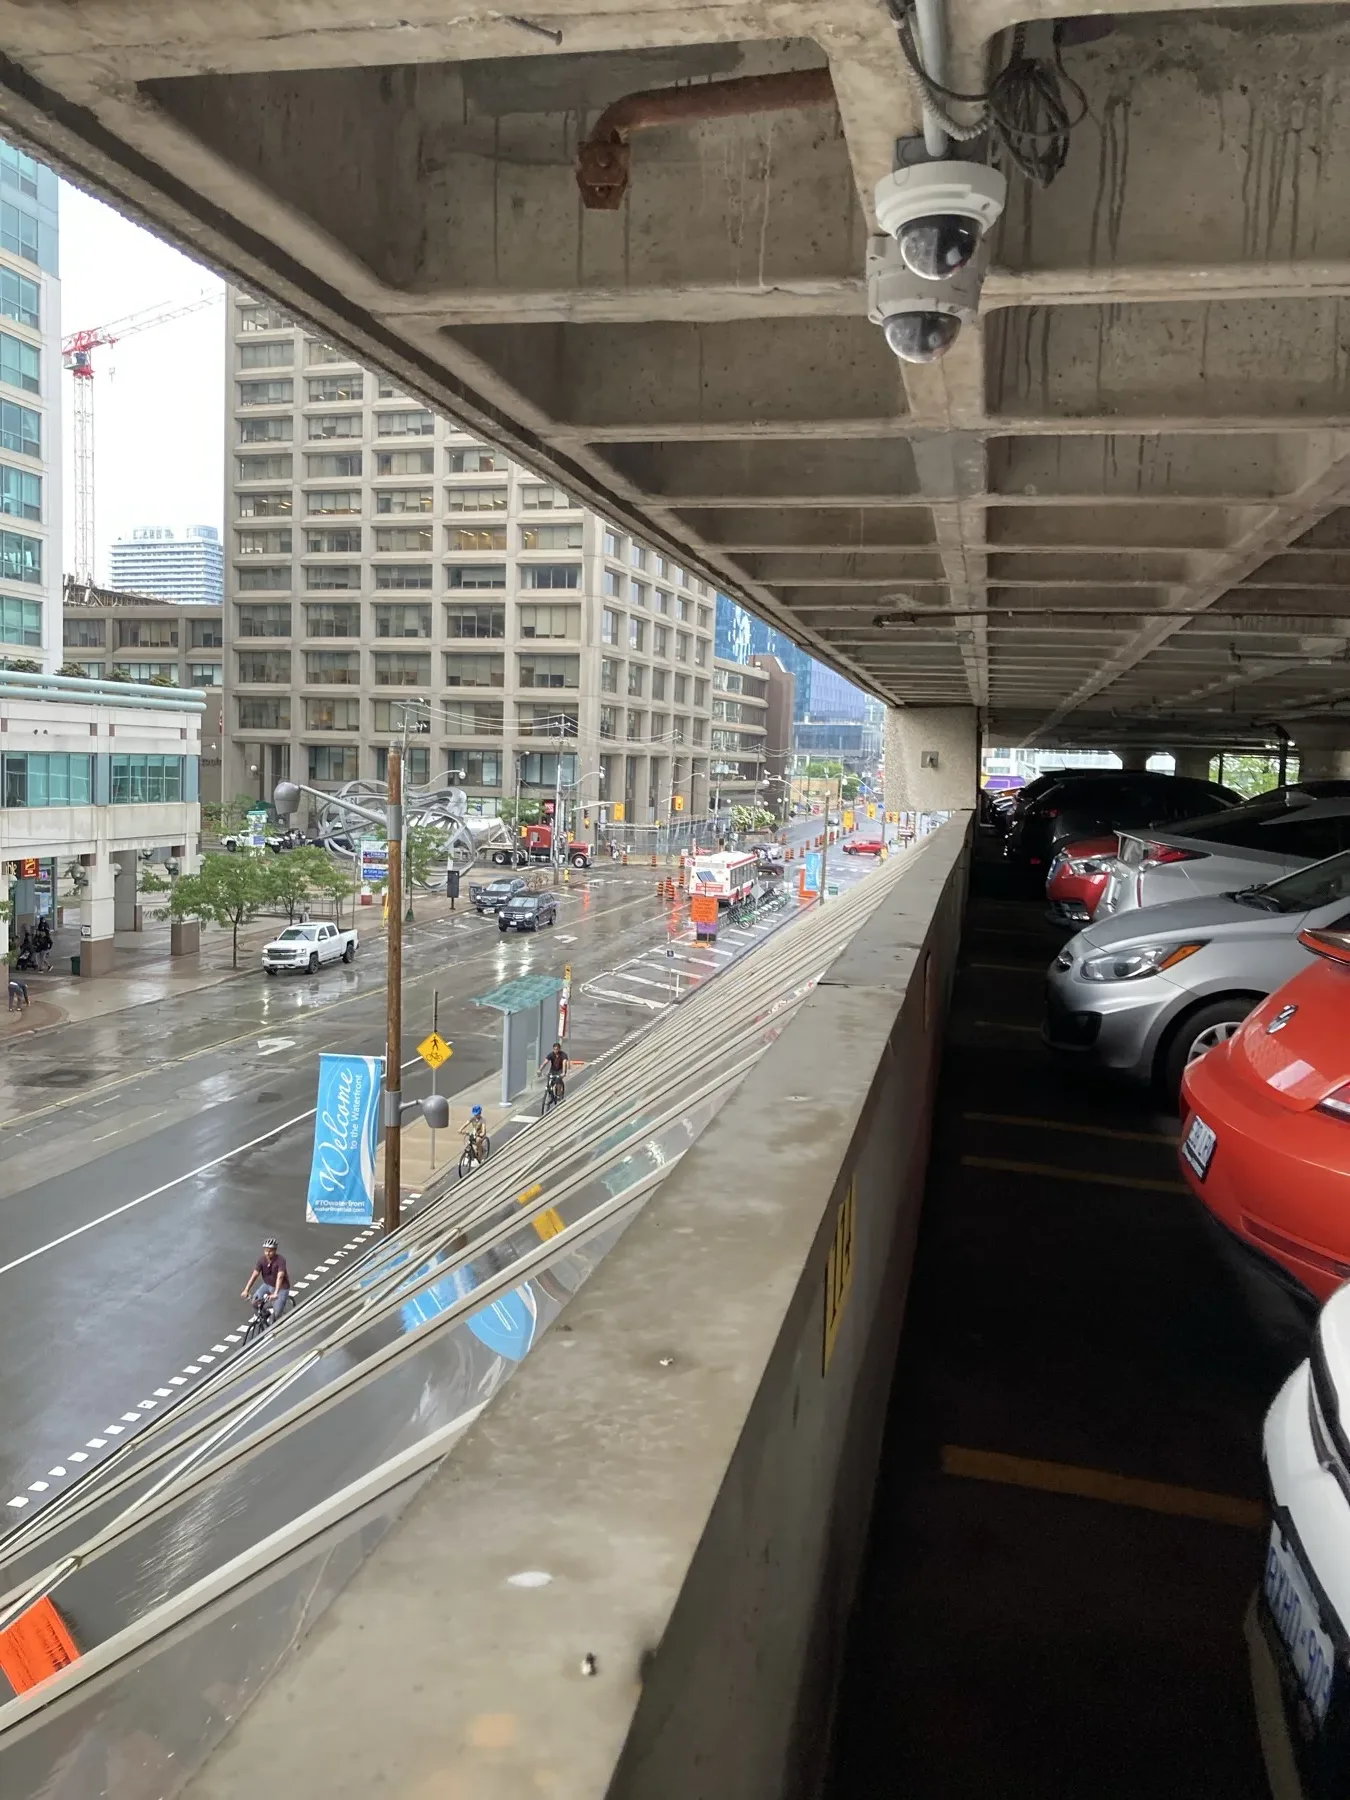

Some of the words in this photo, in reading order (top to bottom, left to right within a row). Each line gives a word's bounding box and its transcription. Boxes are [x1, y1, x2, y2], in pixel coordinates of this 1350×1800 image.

[351, 1074, 363, 1122] Waterfront
[318, 1067, 353, 1192] Welcome
[350, 1124, 358, 1138] the
[350, 1140, 358, 1150] to
